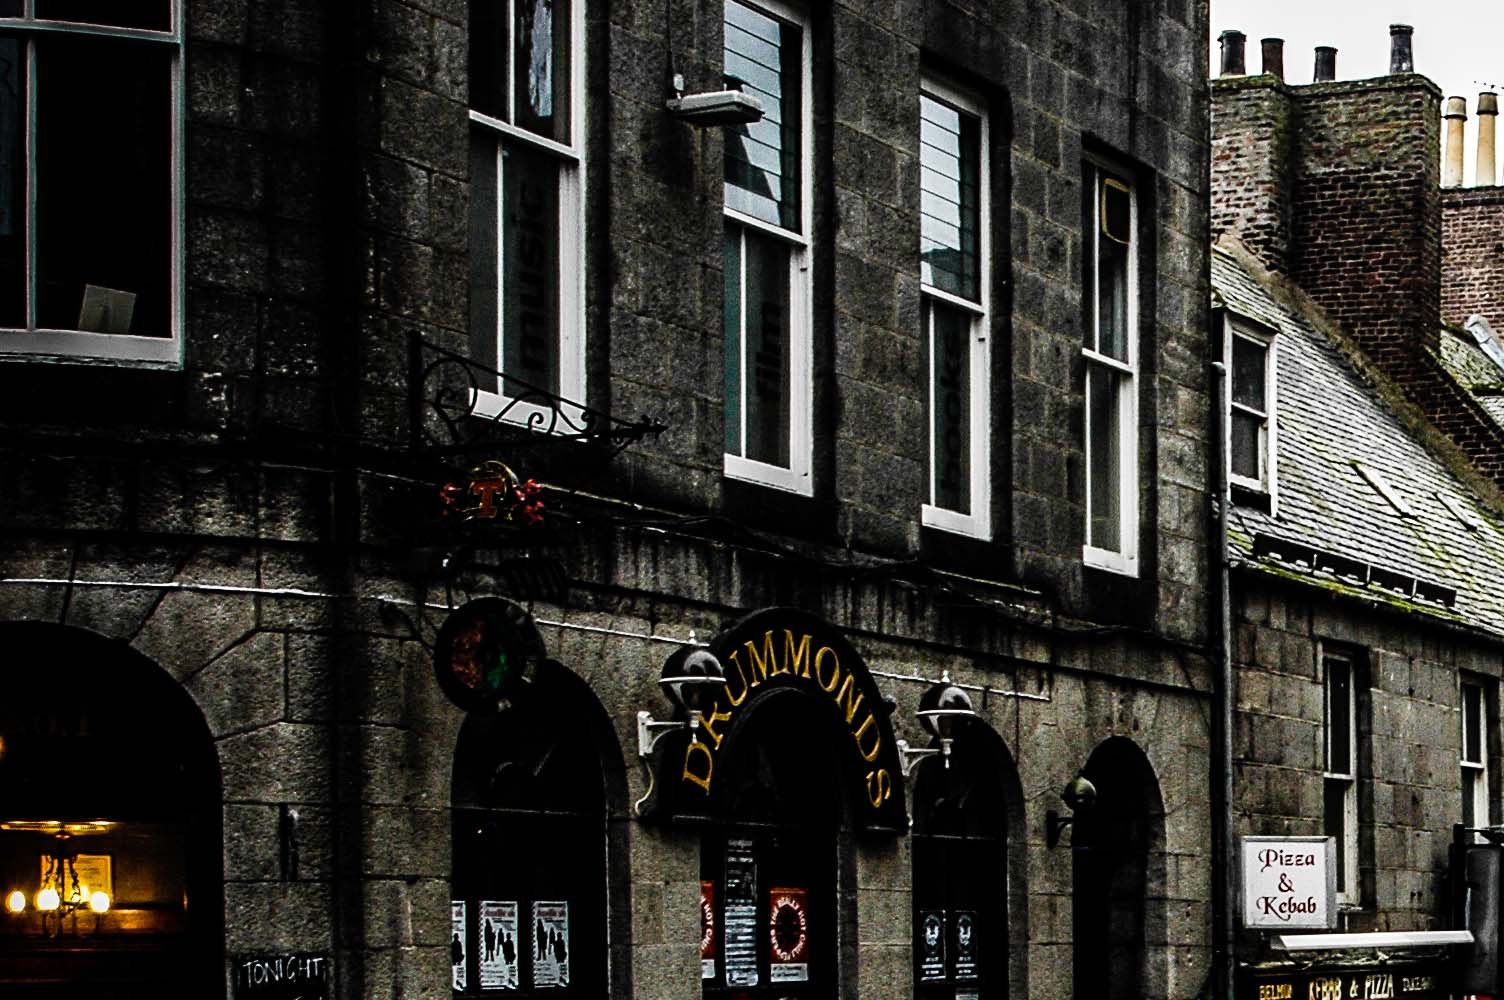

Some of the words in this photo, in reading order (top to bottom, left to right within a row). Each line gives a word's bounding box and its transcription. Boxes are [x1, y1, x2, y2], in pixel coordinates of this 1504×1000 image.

[683, 629, 891, 808] DRUMMONDS
[1258, 849, 1315, 873] Pizza
[1278, 873, 1295, 893] &
[1256, 896, 1317, 921] Kebab
[242, 956, 324, 988] TONIGHT
[1364, 974, 1394, 1000] PIZZA
